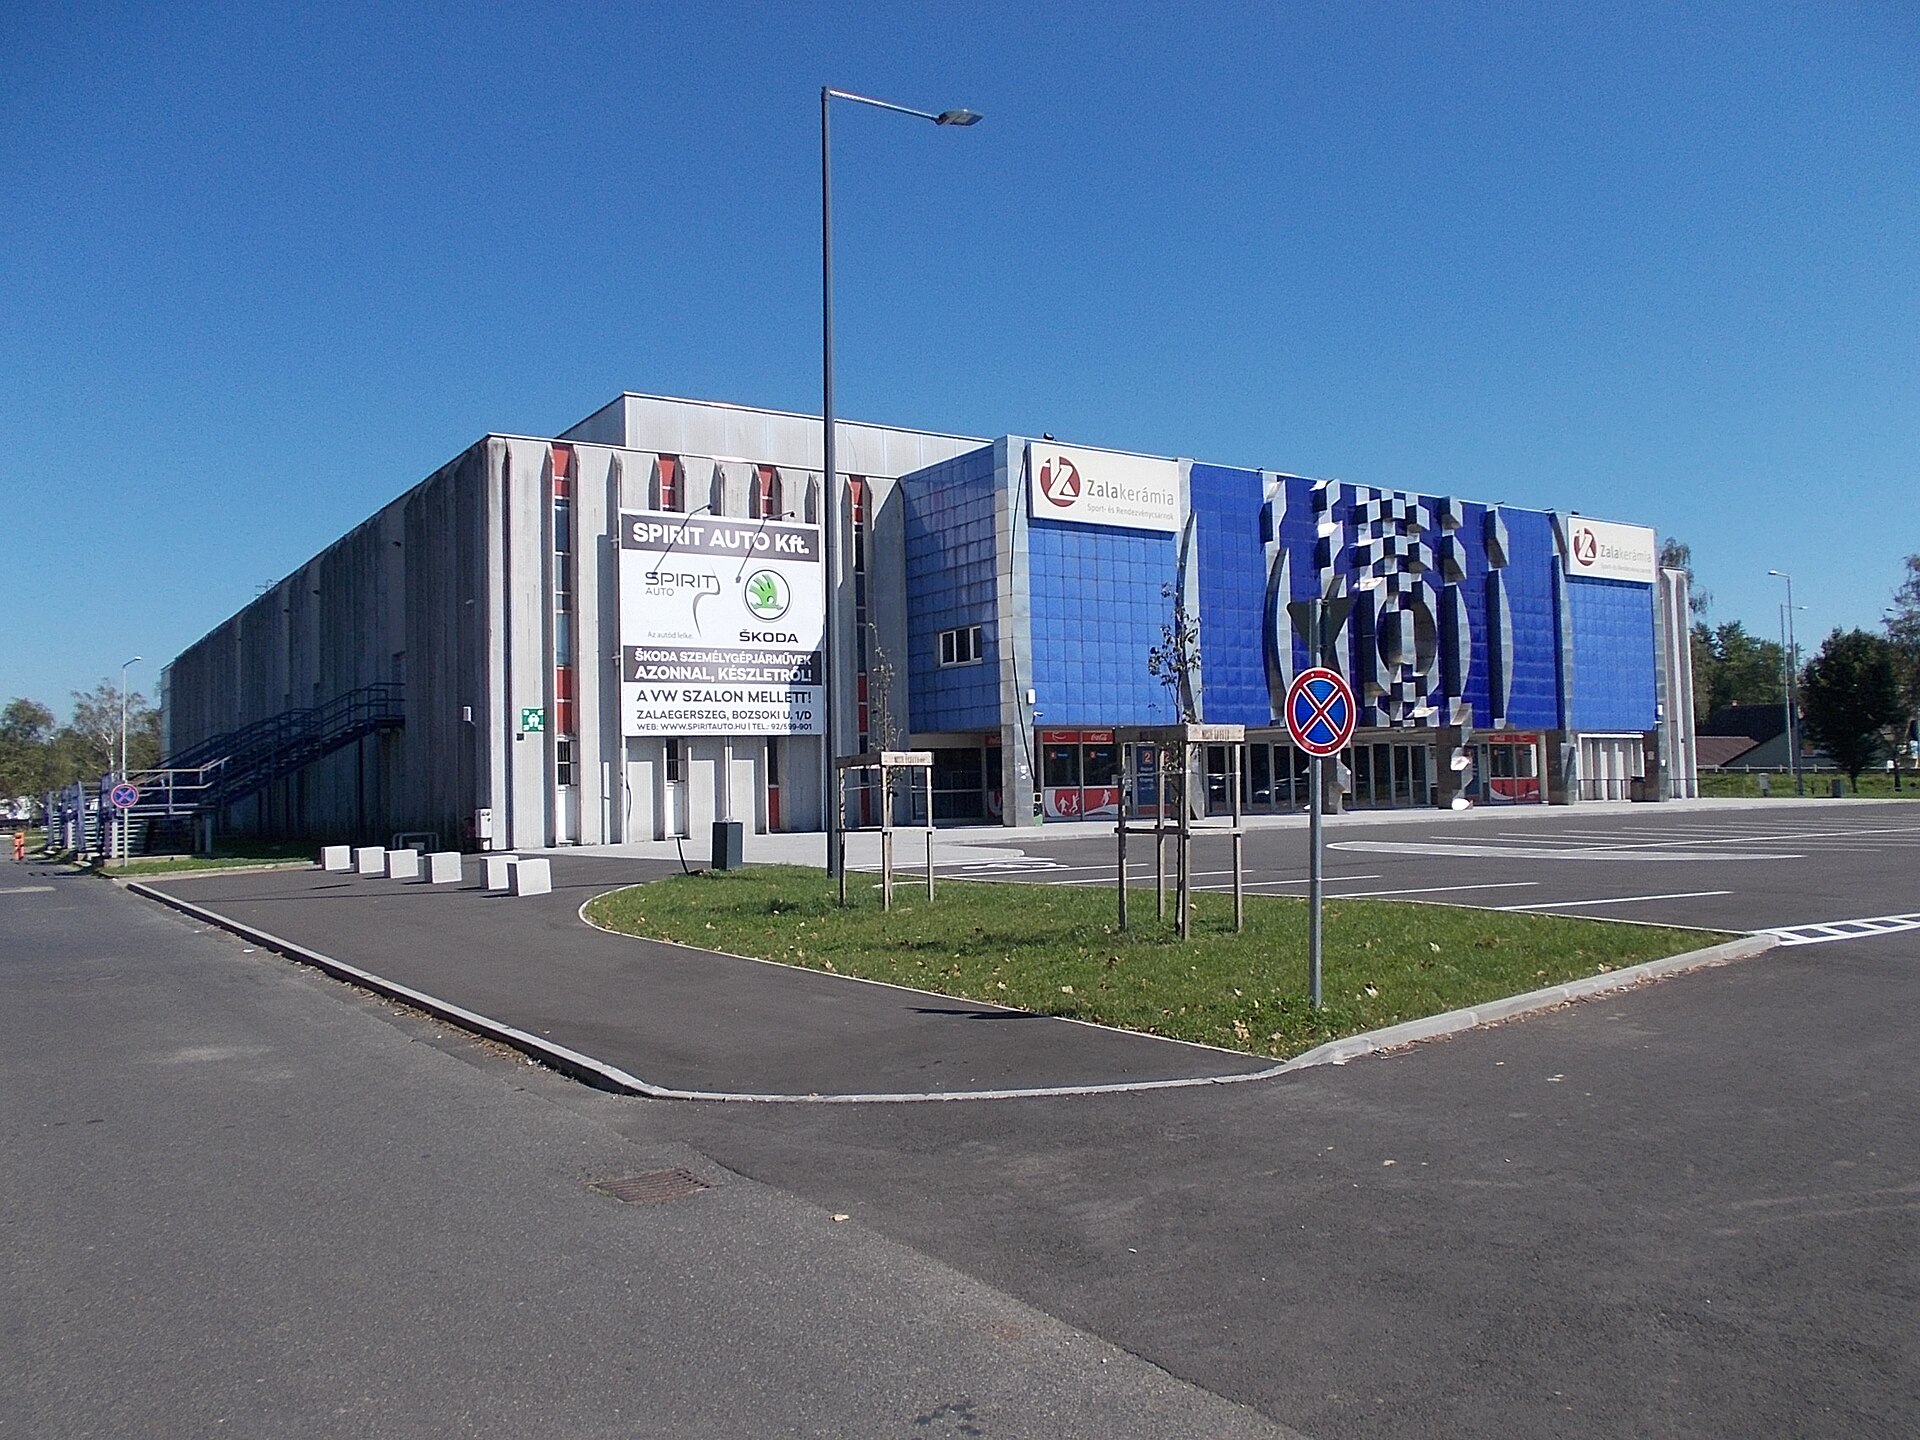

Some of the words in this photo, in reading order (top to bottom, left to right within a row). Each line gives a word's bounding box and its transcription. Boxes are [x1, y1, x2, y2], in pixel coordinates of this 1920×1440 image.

[1087, 479, 1174, 505] Zalakerámia
[1087, 503, 1106, 513] Sport-
[1107, 505, 1115, 514] és
[1116, 506, 1174, 520] Rendezvénycsarnok
[632, 522, 704, 547] SPIRIT
[709, 529, 770, 549] AUTO
[775, 533, 810, 554] Kft.
[1600, 544, 1651, 563] Zalakerámia
[645, 571, 717, 588] SPIRIT
[645, 587, 674, 597] AUTO
[739, 628, 799, 643] ŠKODA
[635, 648, 678, 662] ŠKODA
[679, 650, 812, 665] SZEMÉLYGÉPJÁRMŰVEK
[635, 665, 715, 682] AZONNAL,
[718, 665, 812, 682] KÉSZLETRŐL!
[636, 690, 648, 702] A
[650, 690, 678, 702] VW
[682, 690, 743, 703] SZALON
[748, 691, 812, 704] MELLETT!
[636, 710, 729, 721] ZALAEGERSZEG,
[732, 710, 780, 720] BOZSOKI
[783, 711, 793, 720] U.
[795, 711, 812, 720] 1/D
[637, 723, 658, 731] WEB:
[660, 723, 746, 731] WWW.SPIRITAUTO.HU
